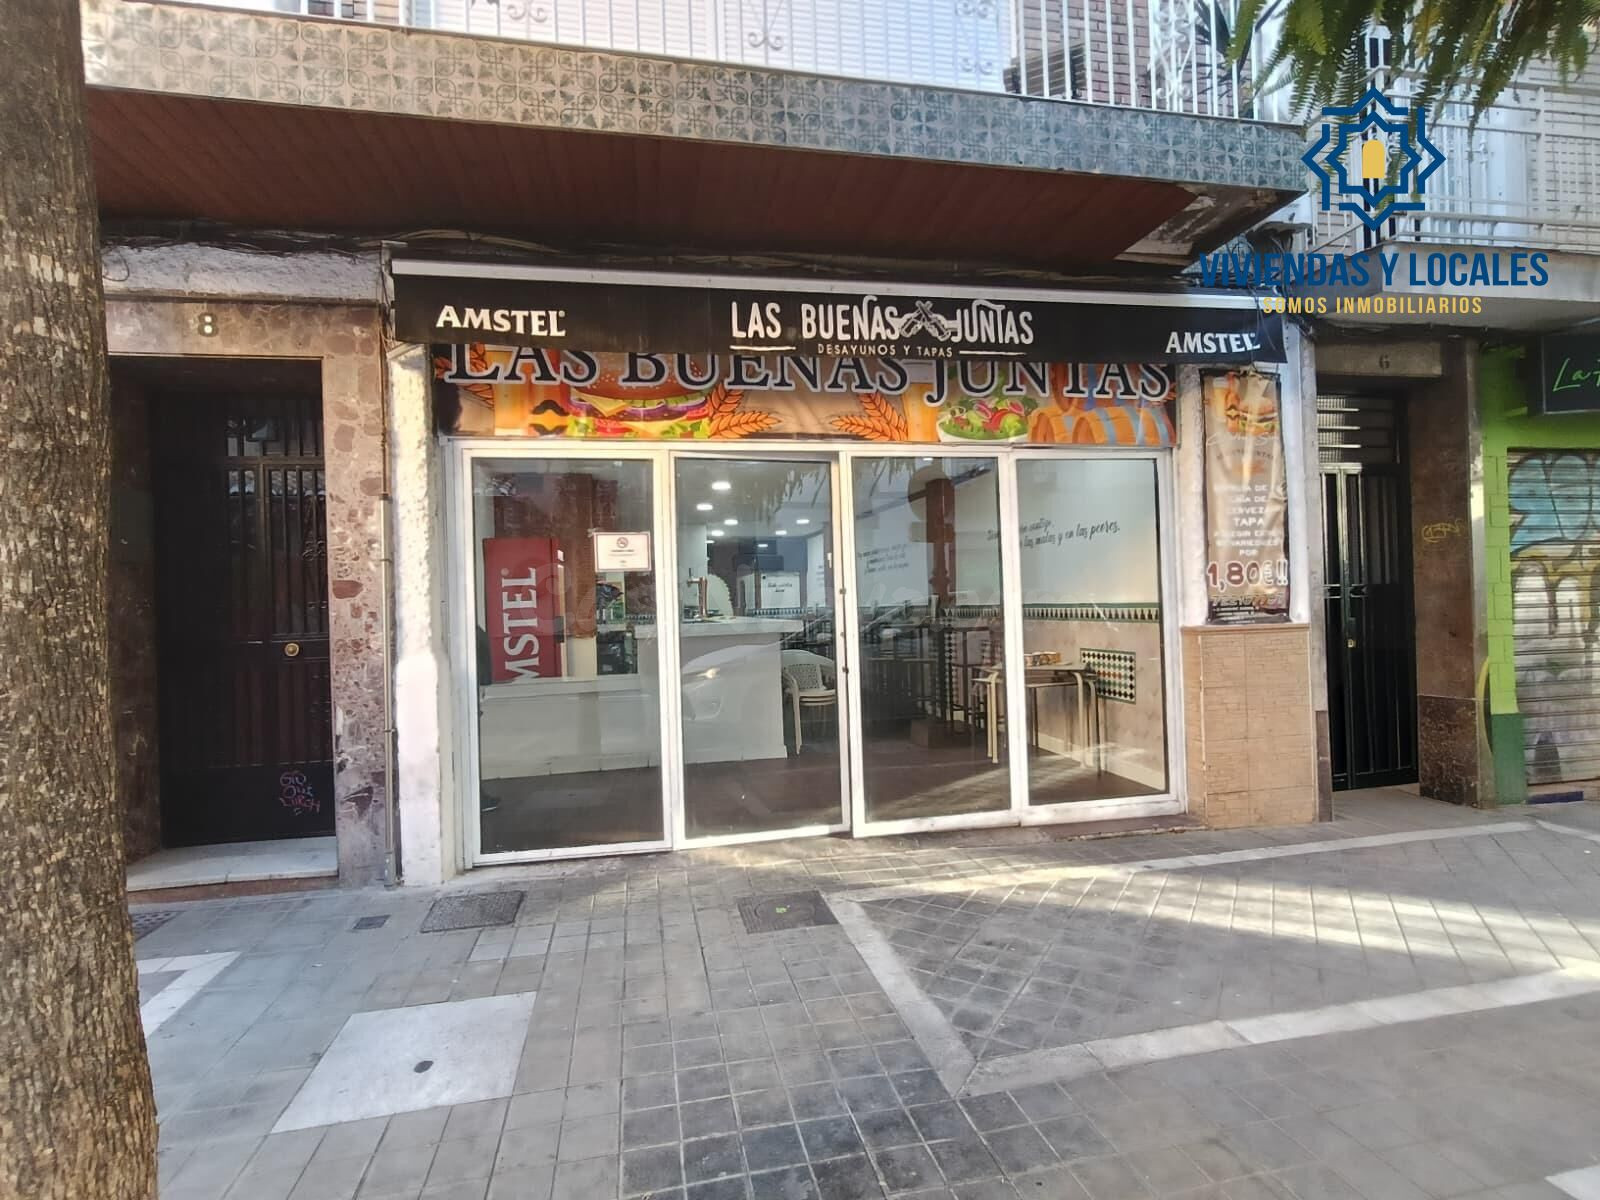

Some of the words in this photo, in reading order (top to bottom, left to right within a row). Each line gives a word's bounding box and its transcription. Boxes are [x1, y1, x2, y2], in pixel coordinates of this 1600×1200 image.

[198, 312, 219, 337] 8
[731, 301, 782, 339] LAS
[950, 299, 1034, 345] JUNTAS
[818, 343, 896, 356] DESAYUNOS
[903, 345, 911, 356] Y
[916, 346, 953, 358] TAPAS
[1234, 517, 1265, 527] TAPA
